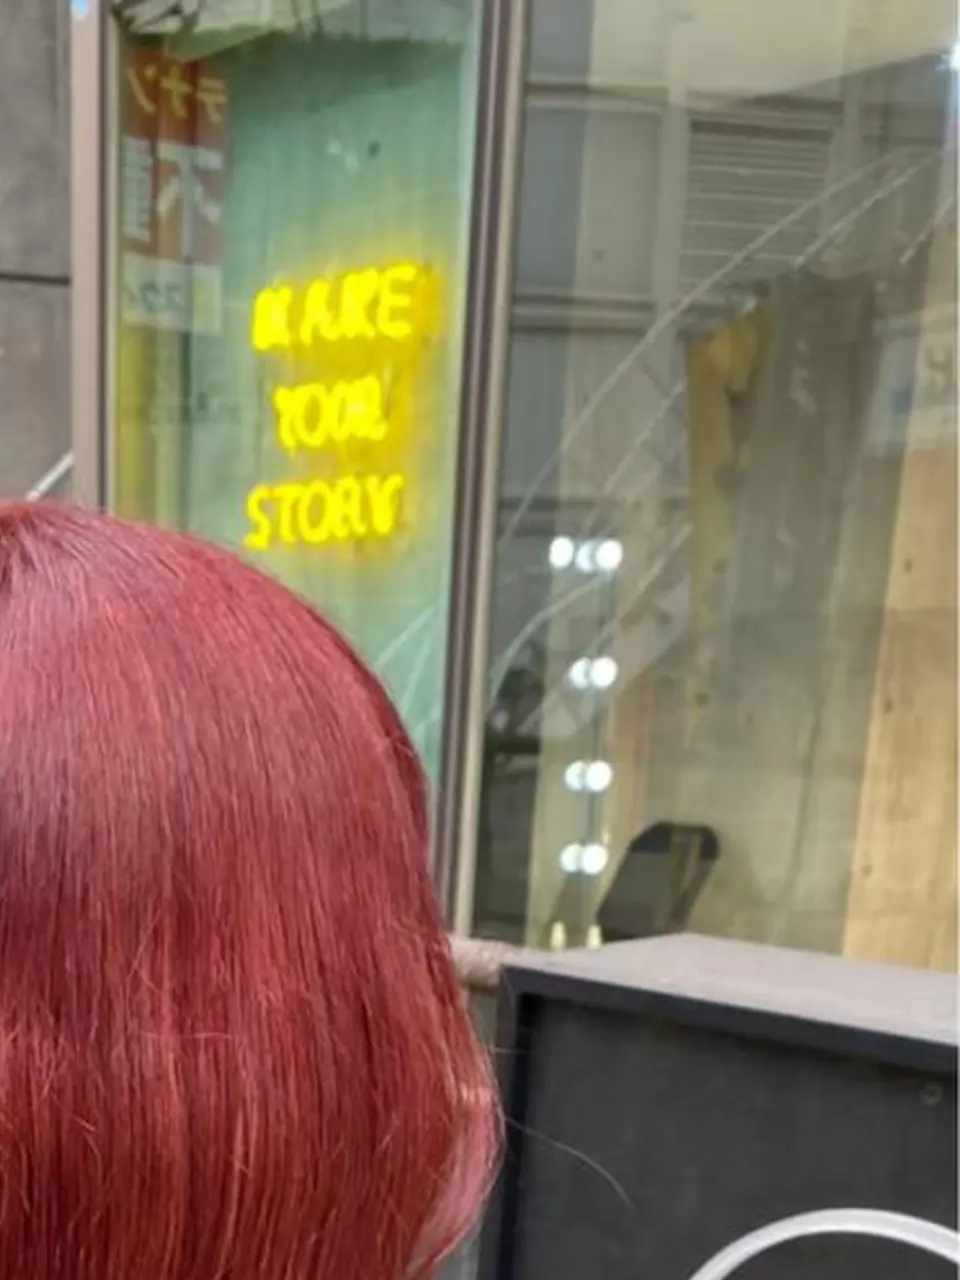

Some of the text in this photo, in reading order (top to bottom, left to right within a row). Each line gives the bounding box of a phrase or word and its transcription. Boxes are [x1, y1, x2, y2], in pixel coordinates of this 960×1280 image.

[252, 264, 417, 350] MAKE
[274, 374, 388, 448] YOUR
[244, 472, 405, 549] STORY
